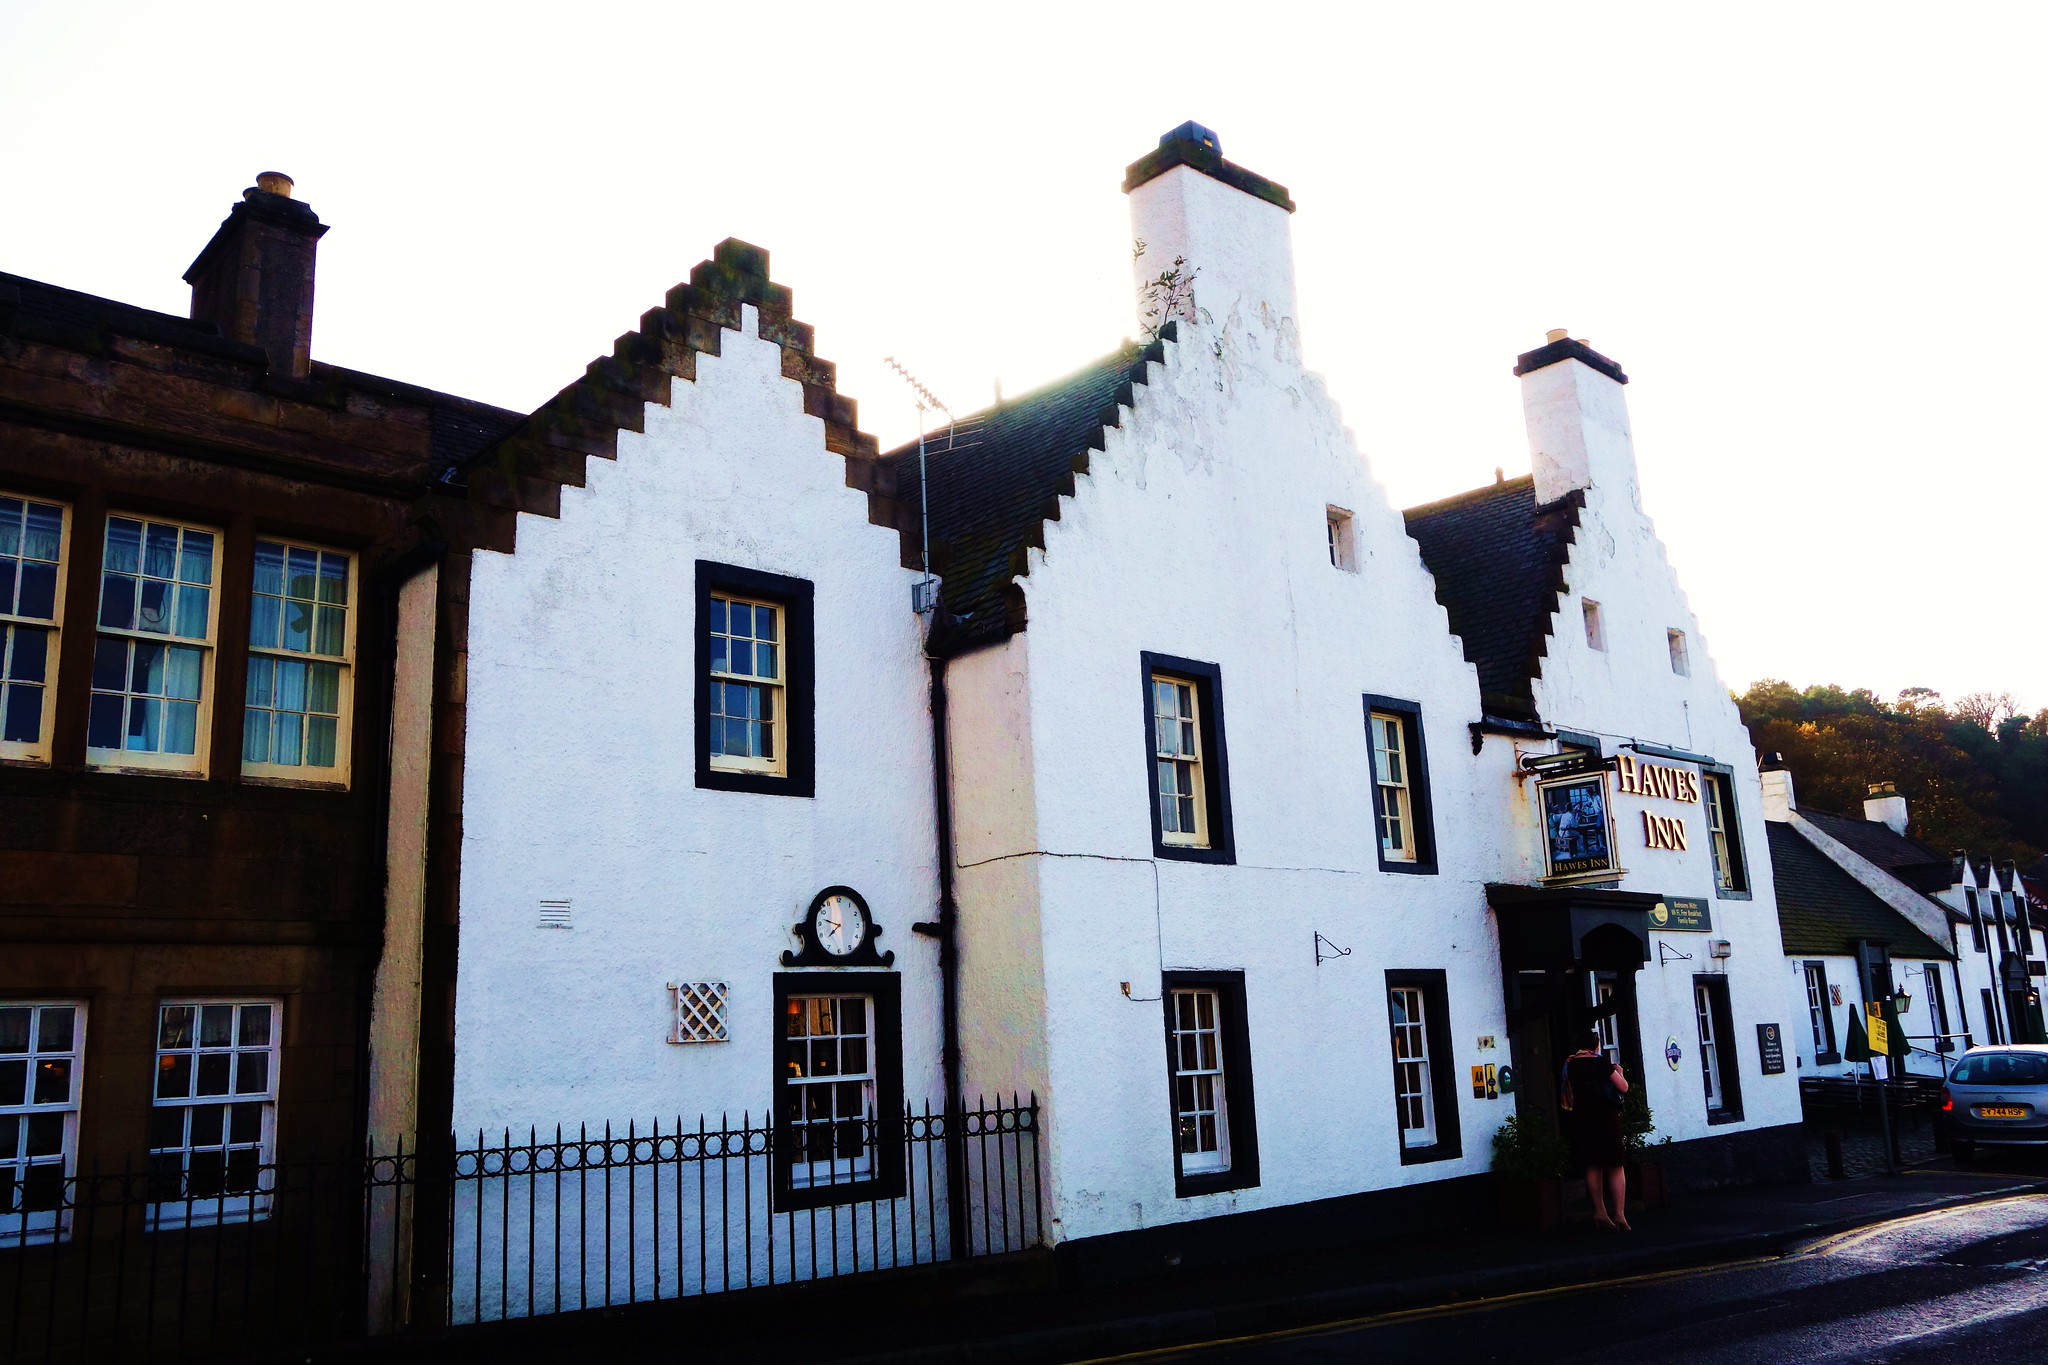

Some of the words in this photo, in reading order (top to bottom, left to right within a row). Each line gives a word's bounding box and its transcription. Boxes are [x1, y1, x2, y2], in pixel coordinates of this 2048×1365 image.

[1617, 754, 1699, 803] HAWES
[1642, 809, 1687, 851] INN
[1554, 861, 1587, 872] HAWES
[1591, 858, 1608, 868] INN
[1475, 1071, 1484, 1083] AA
